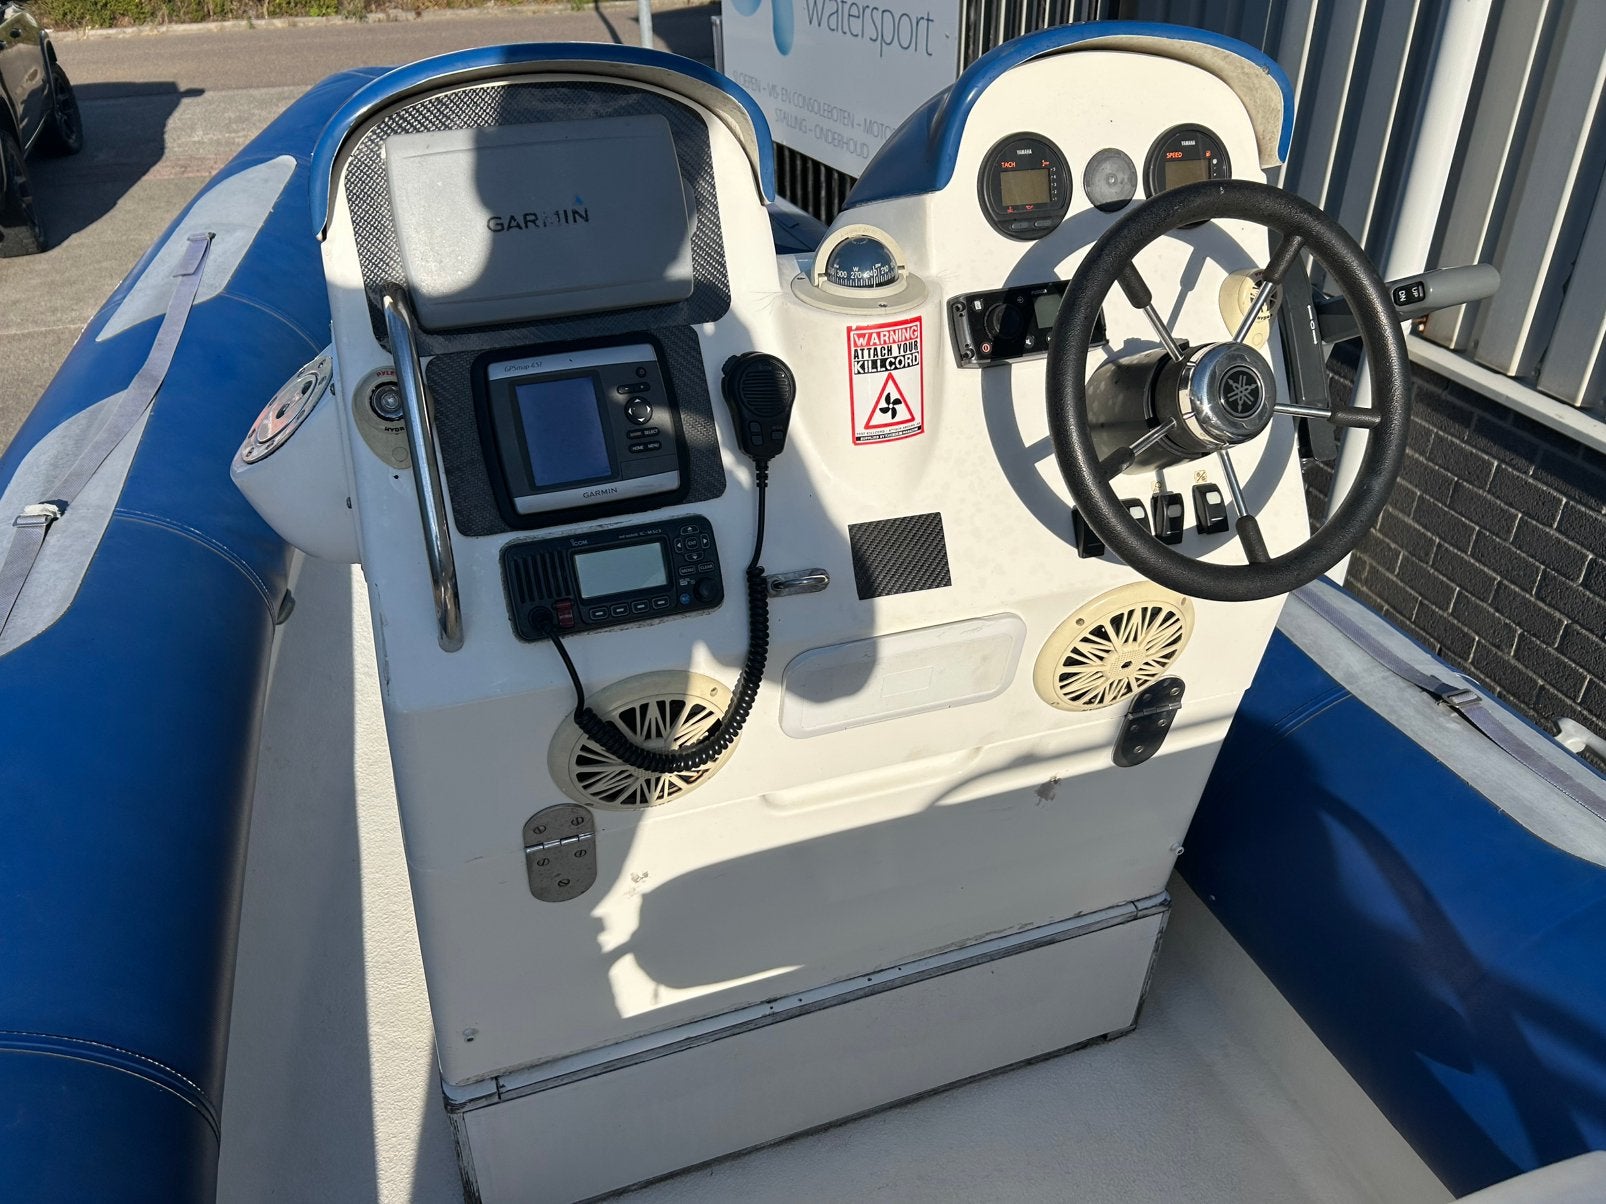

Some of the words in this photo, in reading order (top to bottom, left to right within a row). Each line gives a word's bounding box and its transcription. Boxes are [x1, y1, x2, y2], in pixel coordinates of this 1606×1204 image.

[805, 0, 934, 57] watersport
[792, 91, 854, 129] CONSOLEBOTEN
[775, 107, 808, 134] STALLING
[814, 123, 870, 159] ONDERHOUD
[1166, 151, 1183, 159] SPEED
[851, 271, 862, 279] 270
[1398, 290, 1407, 302] DN
[1411, 286, 1419, 298] UP
[854, 325, 918, 348] WARNING
[854, 343, 892, 360] ATTACH
[897, 340, 919, 355] YOUR
[582, 487, 618, 499] GARMIN
